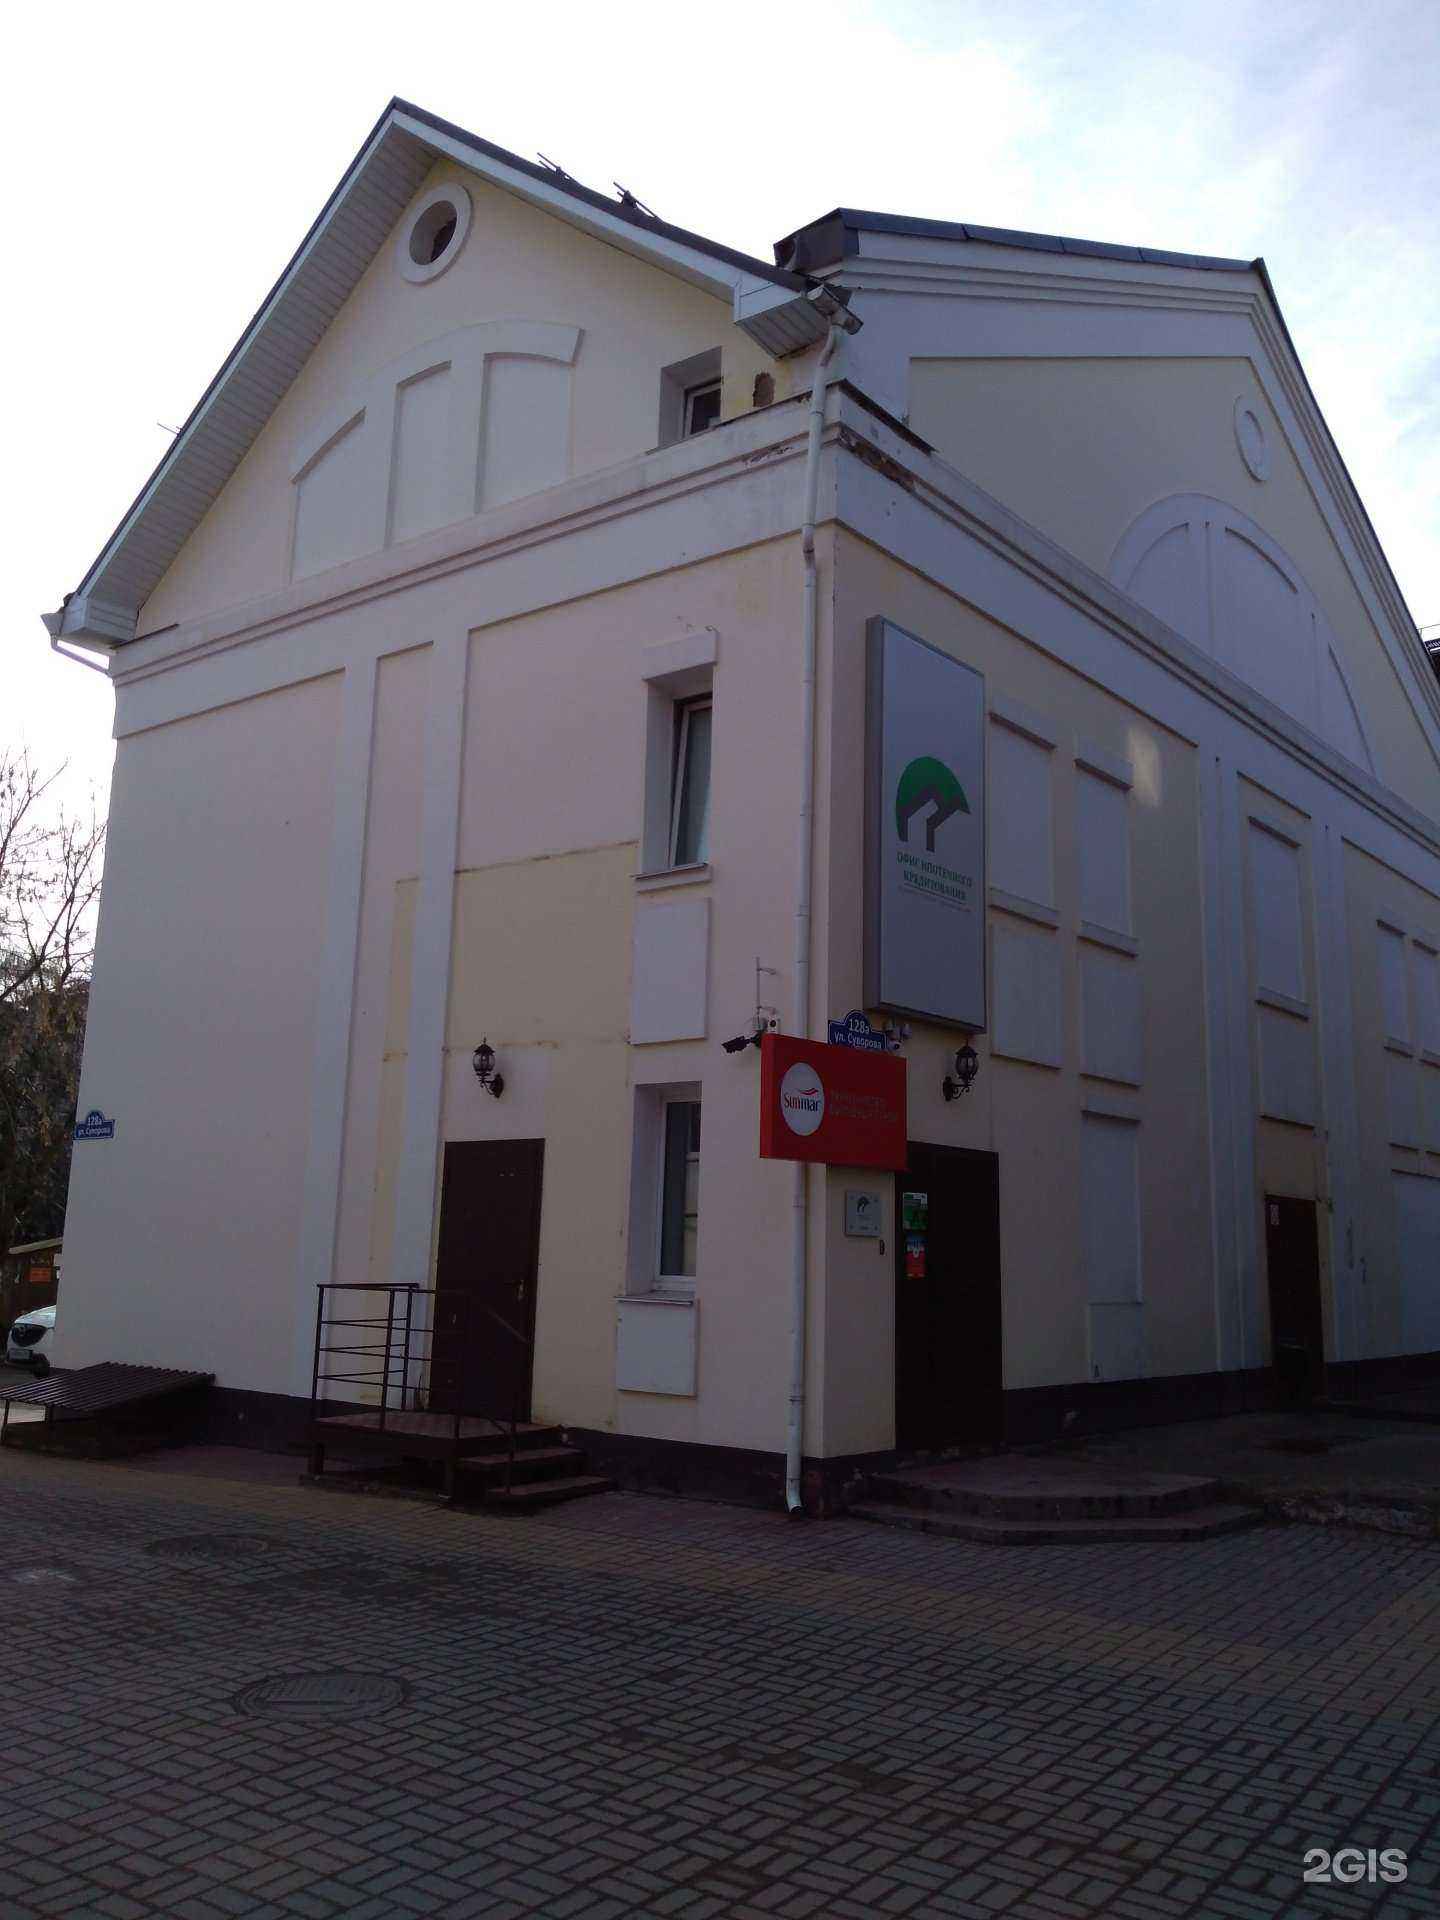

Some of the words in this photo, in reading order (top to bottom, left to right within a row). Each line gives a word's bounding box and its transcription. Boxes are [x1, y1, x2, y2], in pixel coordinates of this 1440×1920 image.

[896, 851, 920, 867] ОФИС
[921, 860, 973, 888] ИПОТЕЧНОГО
[848, 1018, 870, 1035] 128а
[834, 1031, 846, 1043] ул.
[847, 1032, 882, 1049] Суворова
[784, 1092, 821, 1112] Sunmar
